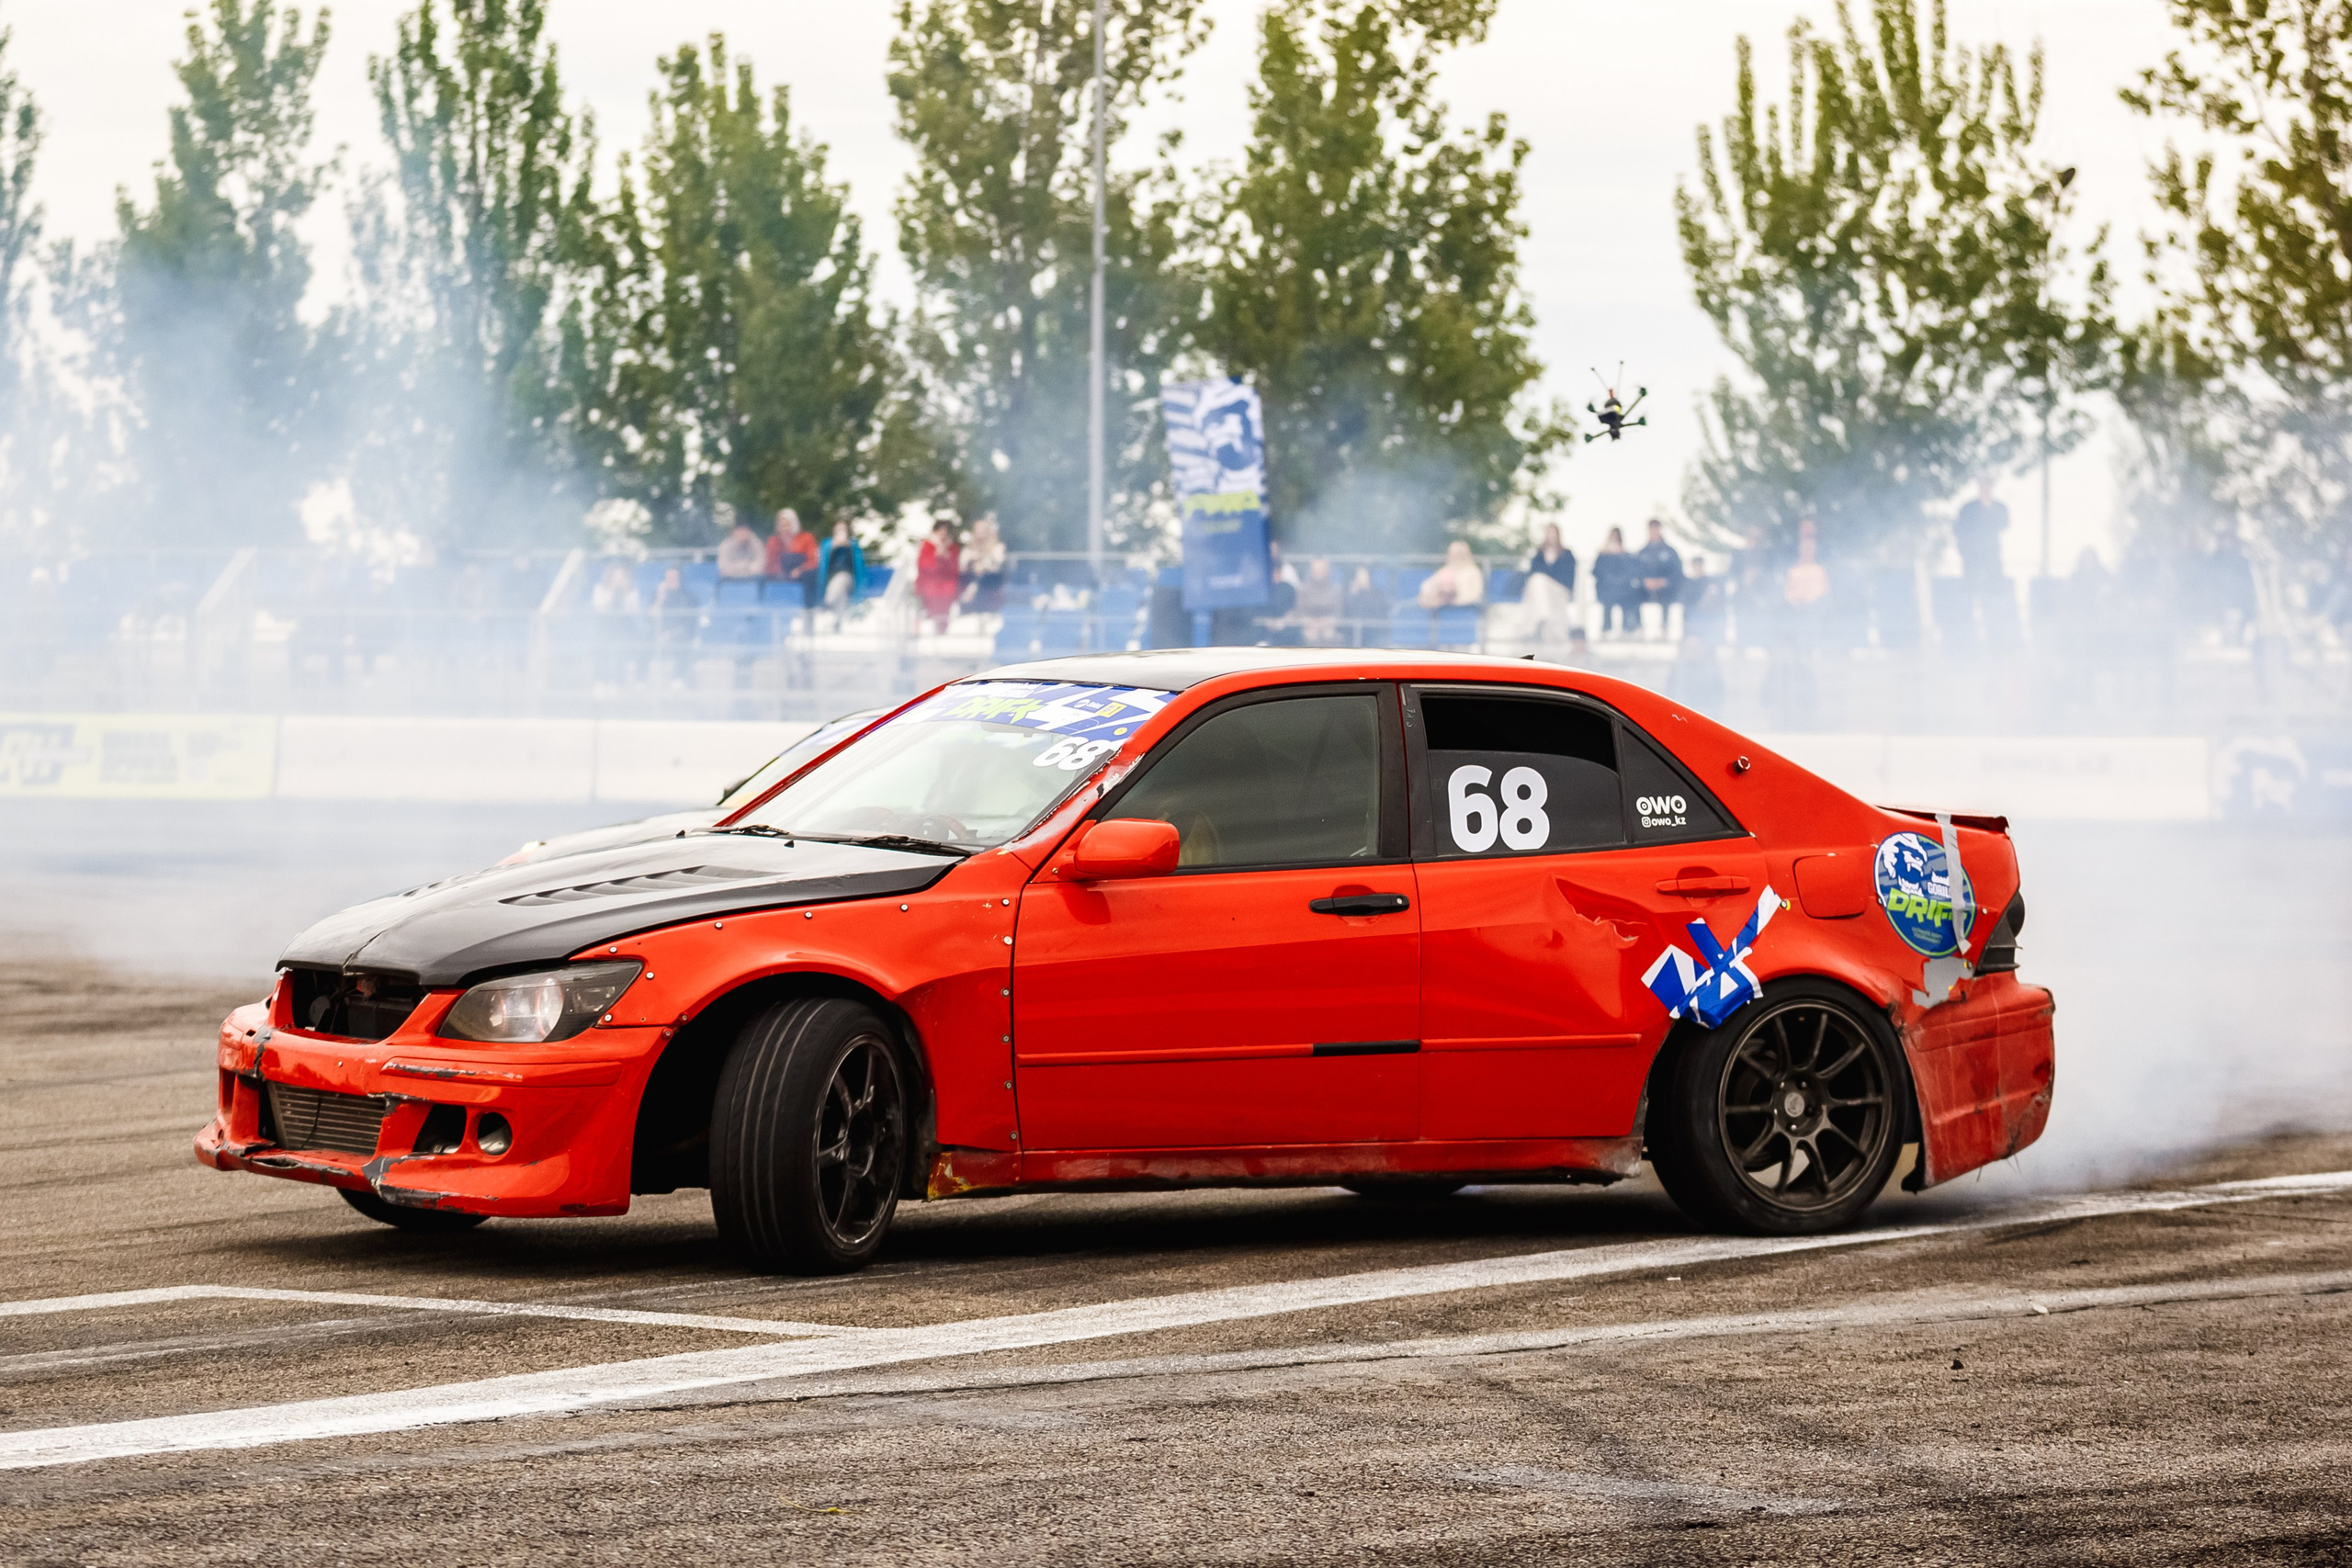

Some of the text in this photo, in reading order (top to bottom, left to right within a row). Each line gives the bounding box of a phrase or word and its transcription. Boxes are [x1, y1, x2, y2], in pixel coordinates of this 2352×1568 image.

[943, 697, 1044, 724] DRIFT
[1033, 737, 1110, 771] 68
[1447, 764, 1550, 852] 68
[1927, 881, 1952, 898] GORIL
[1887, 888, 1967, 928] DRIF
